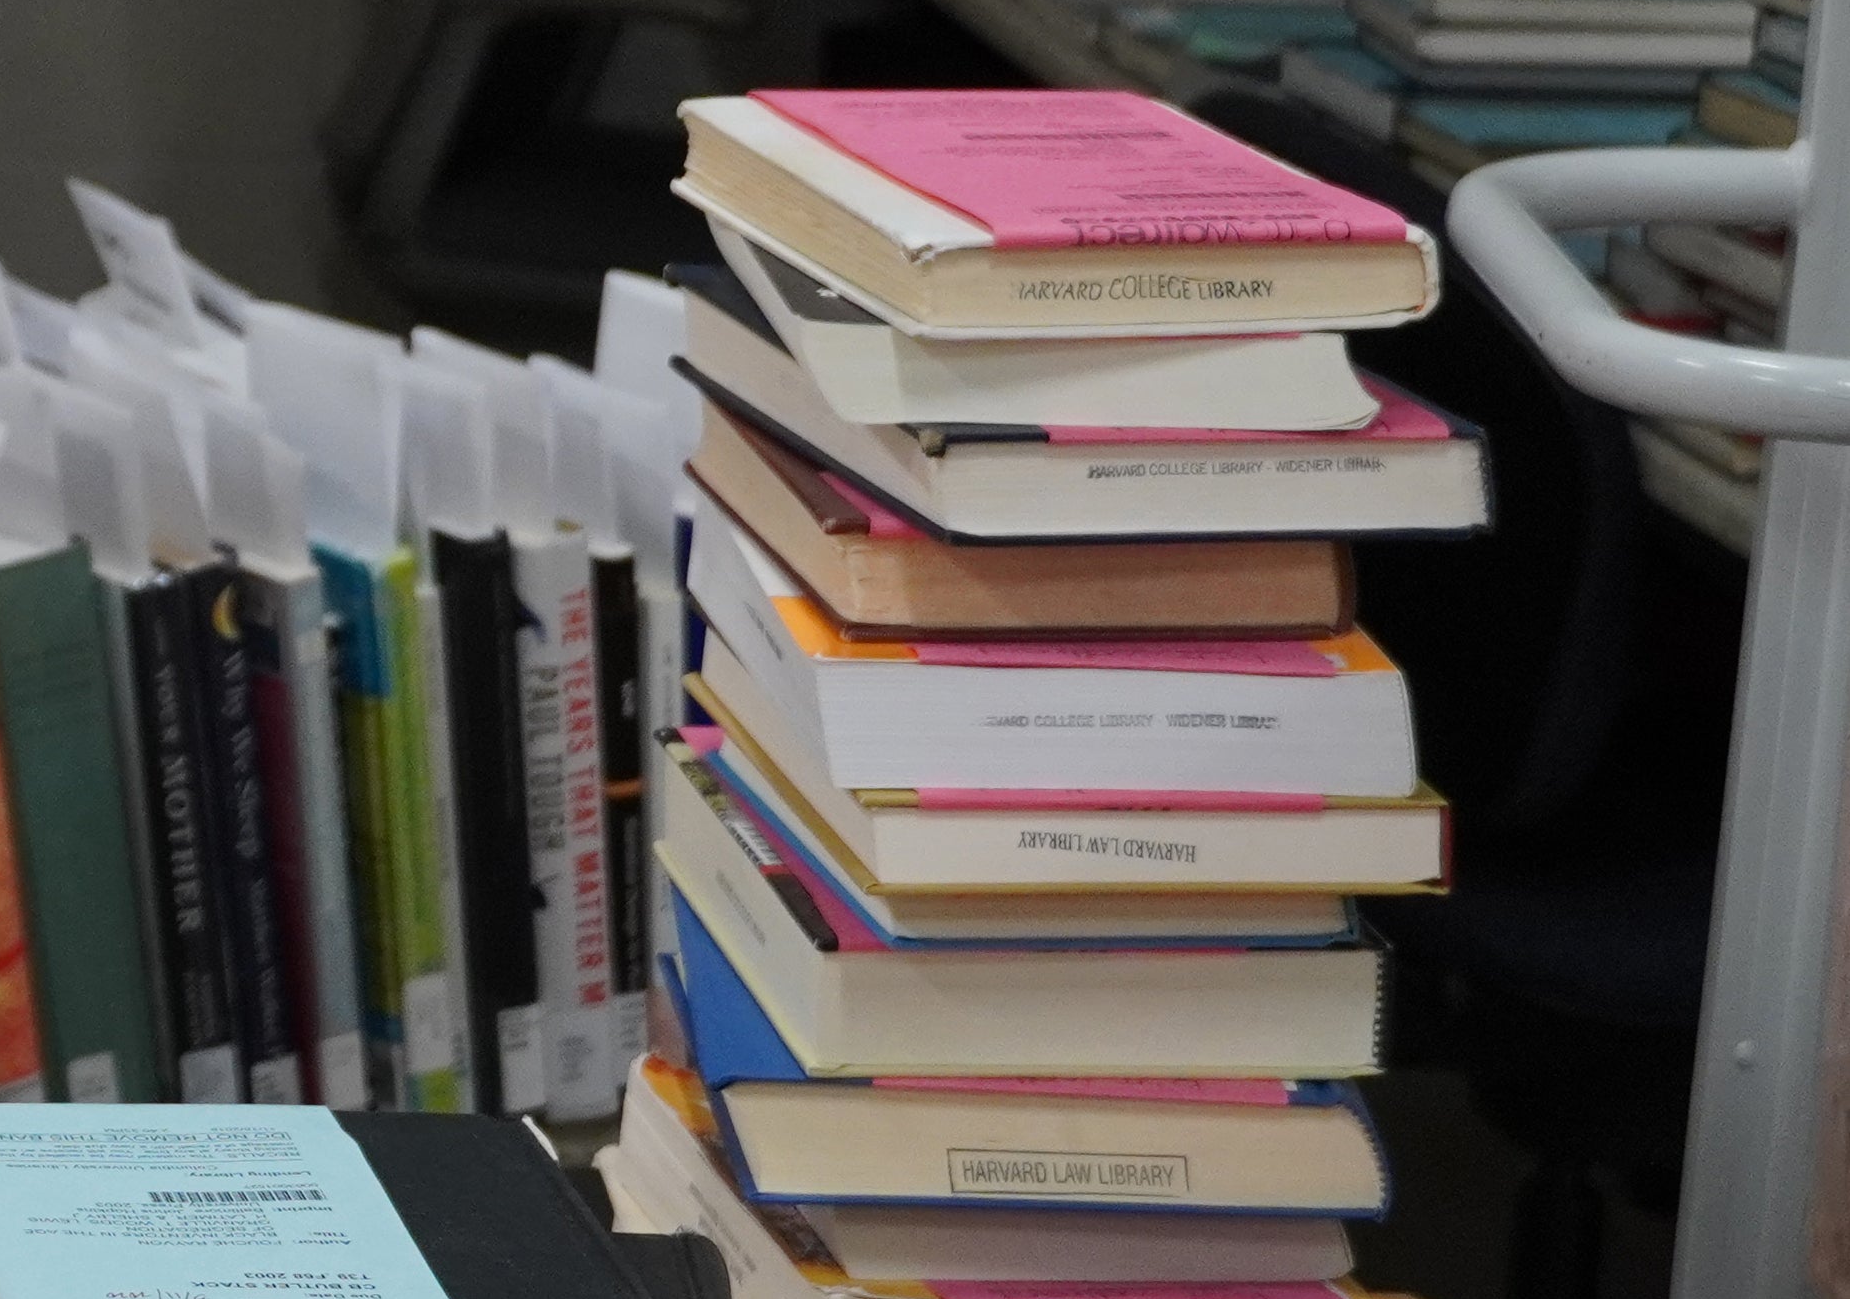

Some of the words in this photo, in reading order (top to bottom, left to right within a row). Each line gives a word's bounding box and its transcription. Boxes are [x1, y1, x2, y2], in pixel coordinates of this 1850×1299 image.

[1109, 275, 1192, 301] COLLEGE
[1198, 281, 1274, 301] LIBRARY
[1087, 464, 1146, 478] HARVARD
[1149, 461, 1208, 475] COLLEGE
[1212, 460, 1263, 474] LIBRARY
[1277, 459, 1332, 473] WIDENER
[560, 586, 591, 648] THE
[562, 657, 595, 756] YEARS
[567, 762, 599, 839] THAT
[160, 753, 205, 935] MOTHER
[1018, 831, 1081, 852] LIBRARY
[1085, 837, 1119, 856] LAW
[1123, 840, 1196, 863] HARVARD
[571, 848, 604, 971] MATTER
[962, 1160, 1047, 1183] HARVARD
[1054, 1163, 1091, 1183] LAW
[1098, 1164, 1174, 1187] LIBRARY
[243, 1272, 285, 1280] 2003
[263, 1282, 339, 1290] BUTLER
